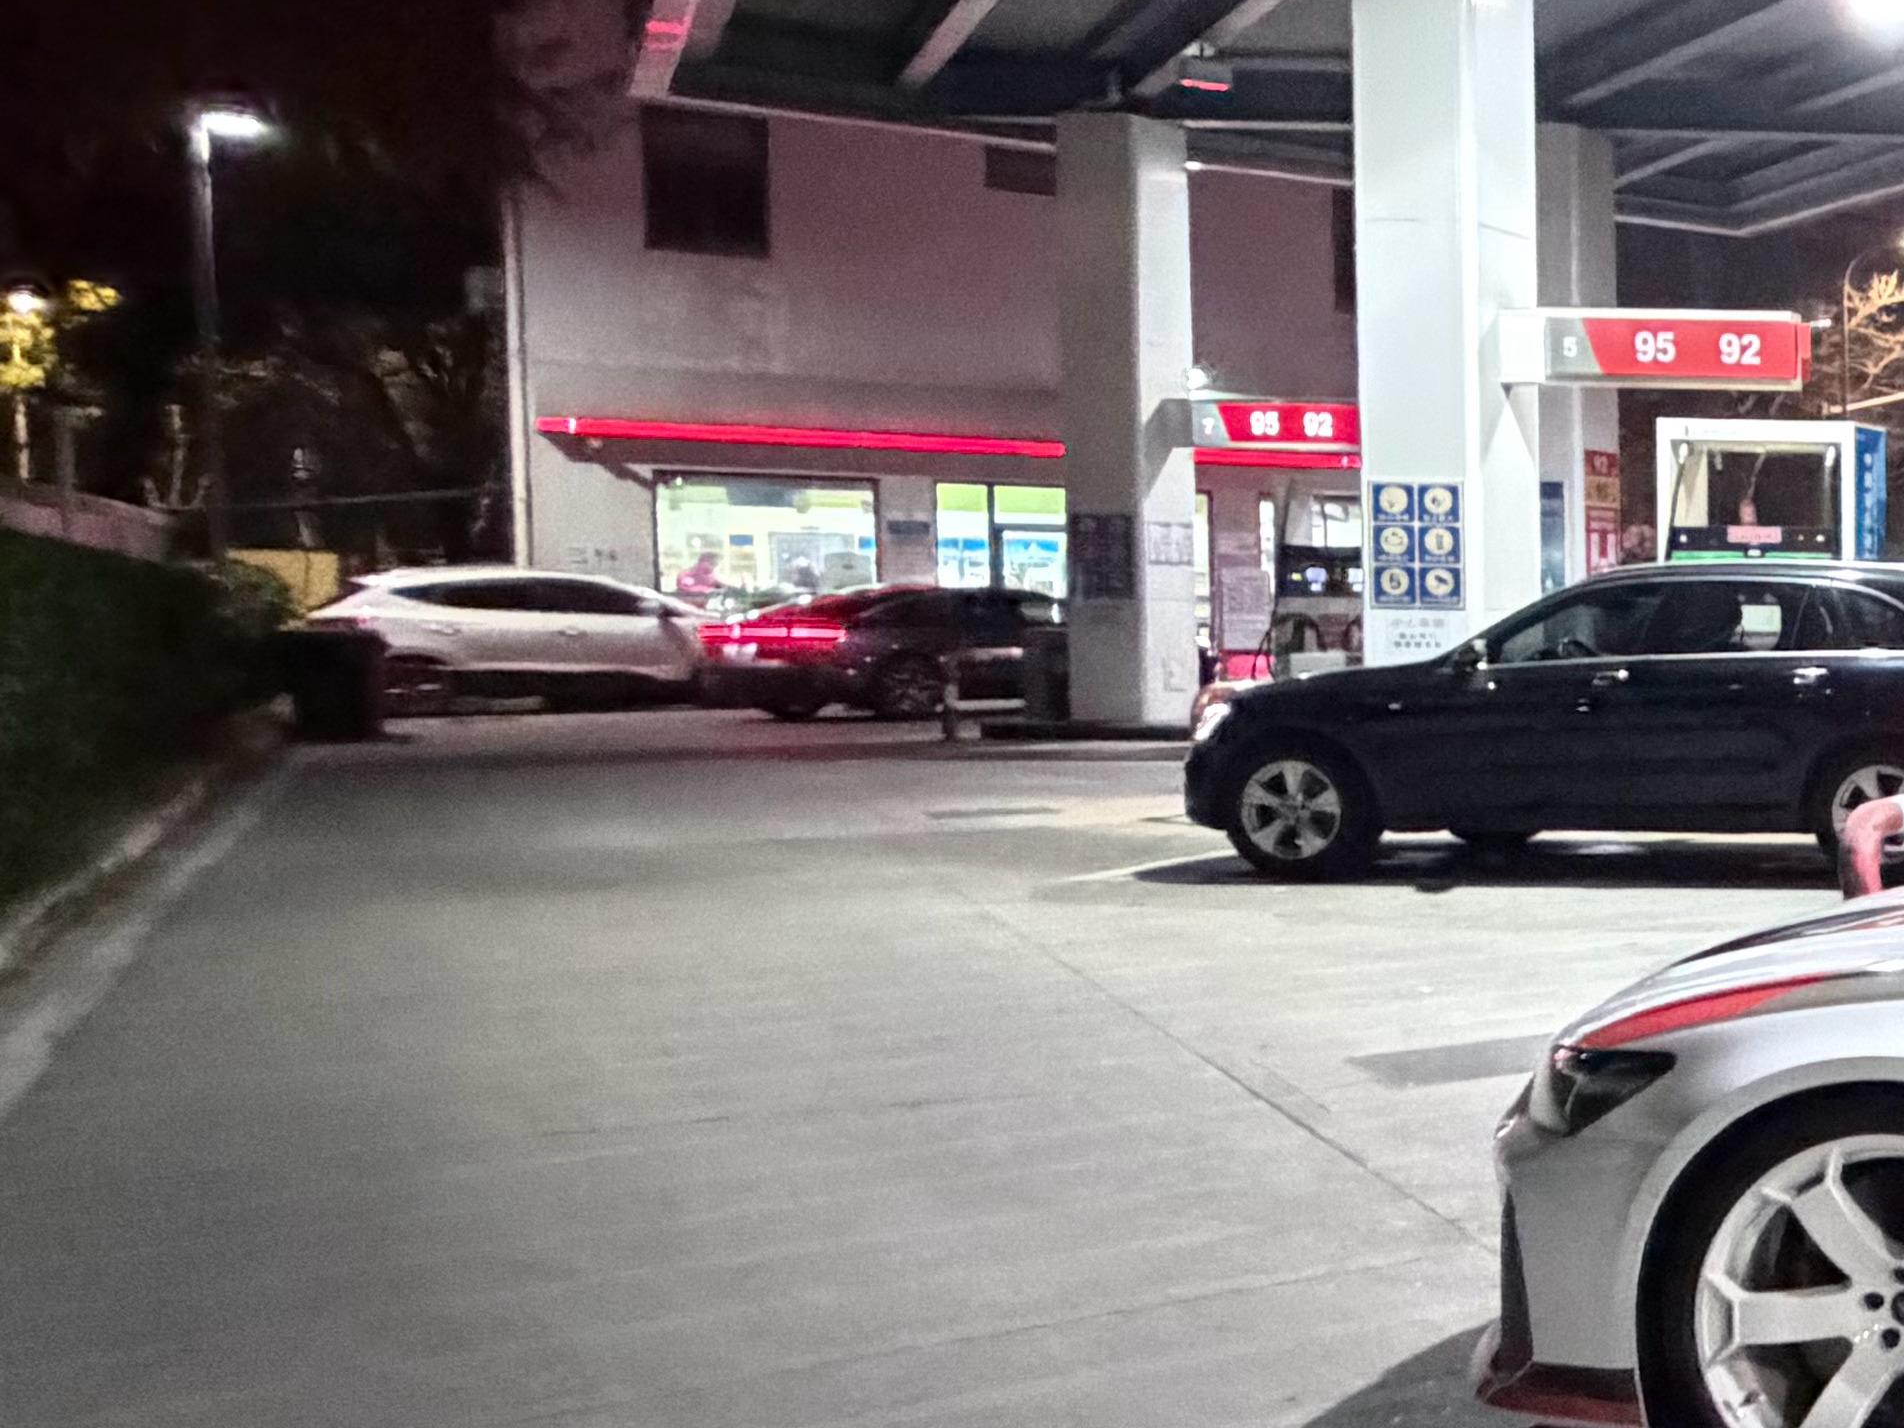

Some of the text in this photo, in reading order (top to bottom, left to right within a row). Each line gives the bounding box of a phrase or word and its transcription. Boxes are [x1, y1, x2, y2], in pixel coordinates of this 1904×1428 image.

[1562, 330, 1762, 366] 5 95 92
[1202, 410, 1333, 437] 7 95 92
